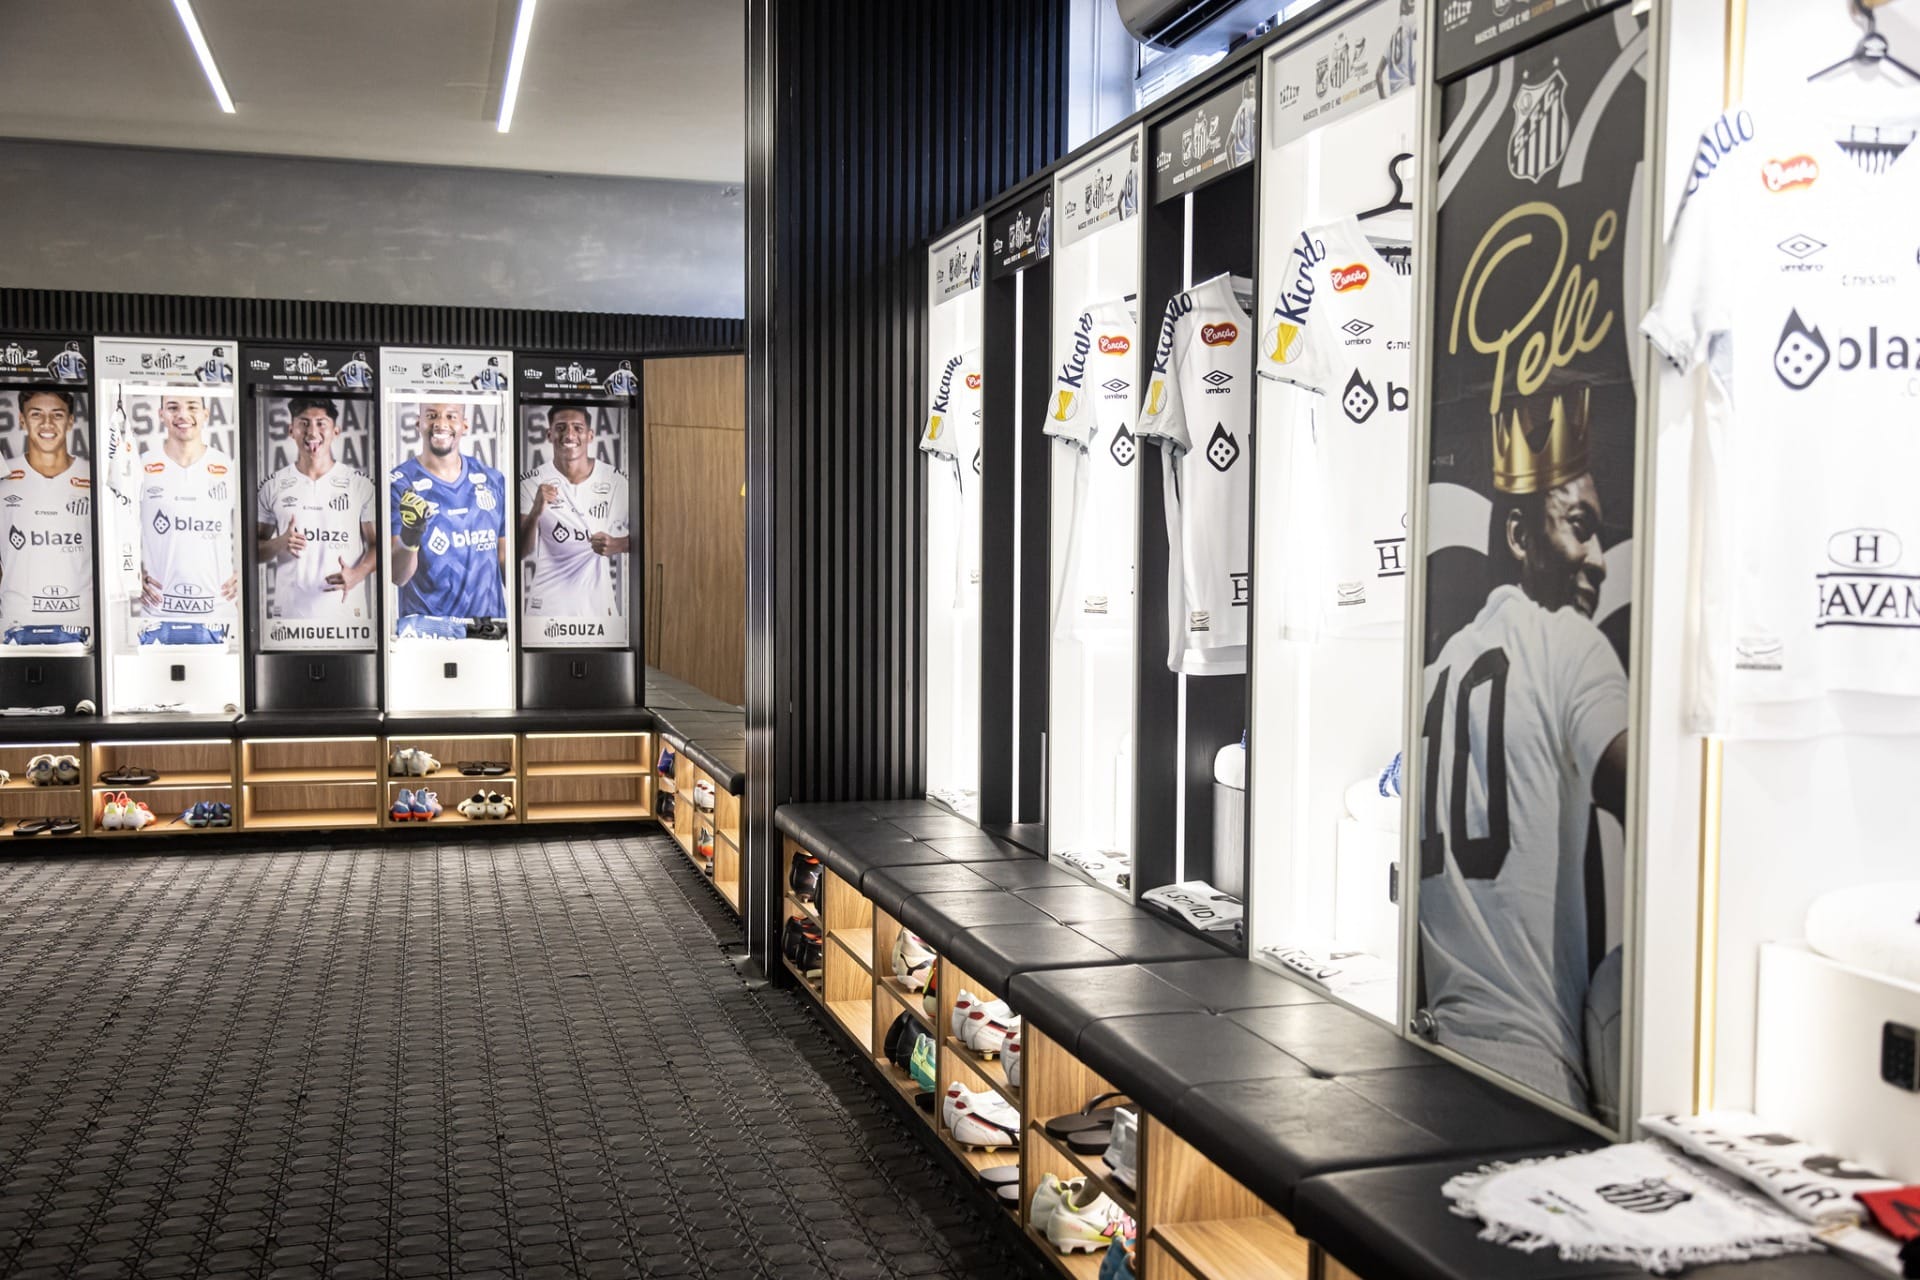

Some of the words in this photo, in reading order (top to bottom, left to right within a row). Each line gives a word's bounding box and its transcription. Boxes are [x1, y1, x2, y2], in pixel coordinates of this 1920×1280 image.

[1449, 201, 1617, 414] Pelé
[1344, 337, 1371, 346] umbro
[1205, 386, 1231, 394] umbro
[175, 516, 222, 532] blaze
[31, 531, 82, 546] blaze
[304, 528, 349, 543] blaze
[452, 529, 496, 548] blaze
[475, 542, 497, 552] .com
[1853, 535, 1880, 563] H
[51, 587, 59, 596] H
[183, 585, 192, 595] H
[33, 598, 80, 611] HAVAN
[162, 597, 214, 611] HAVAN
[287, 626, 370, 639] MIGUELITO
[559, 624, 605, 636] SOUZA
[1421, 646, 1510, 881] 10
